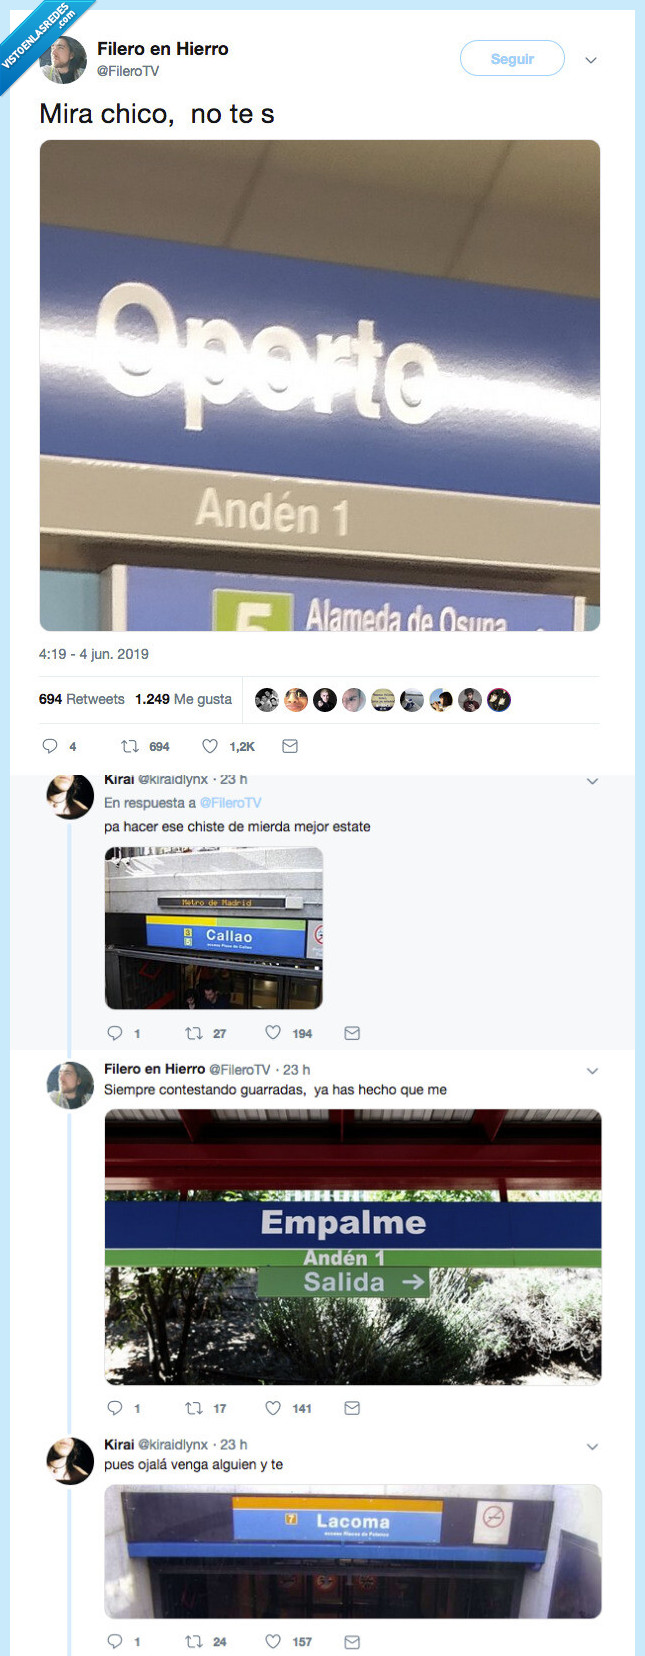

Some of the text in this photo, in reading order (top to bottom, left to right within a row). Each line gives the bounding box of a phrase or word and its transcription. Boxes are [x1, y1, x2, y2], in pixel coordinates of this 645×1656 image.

[97, 40, 229, 56] Filero en Hierro
[490, 52, 535, 68] Seguir
[96, 64, 160, 78] @FileroTV
[39, 102, 274, 128] Mira chico, no te s
[95, 282, 441, 431] Oporto
[195, 487, 349, 536] Andén 1
[305, 597, 507, 631] Alameda de Osuna
[38, 692, 232, 708] 694 Retweets 1.249 Me gusta
[103, 820, 371, 836] pa hacer ese chiste de mierda mejor estate
[181, 898, 253, 907] Metro de Madrid
[206, 928, 253, 943] Callao
[260, 1209, 427, 1241] Empalme
[303, 1249, 386, 1267] Andén 1
[303, 1272, 386, 1293] Salida
[287, 1514, 296, 1525] 7
[316, 1513, 390, 1529] Lacoma
